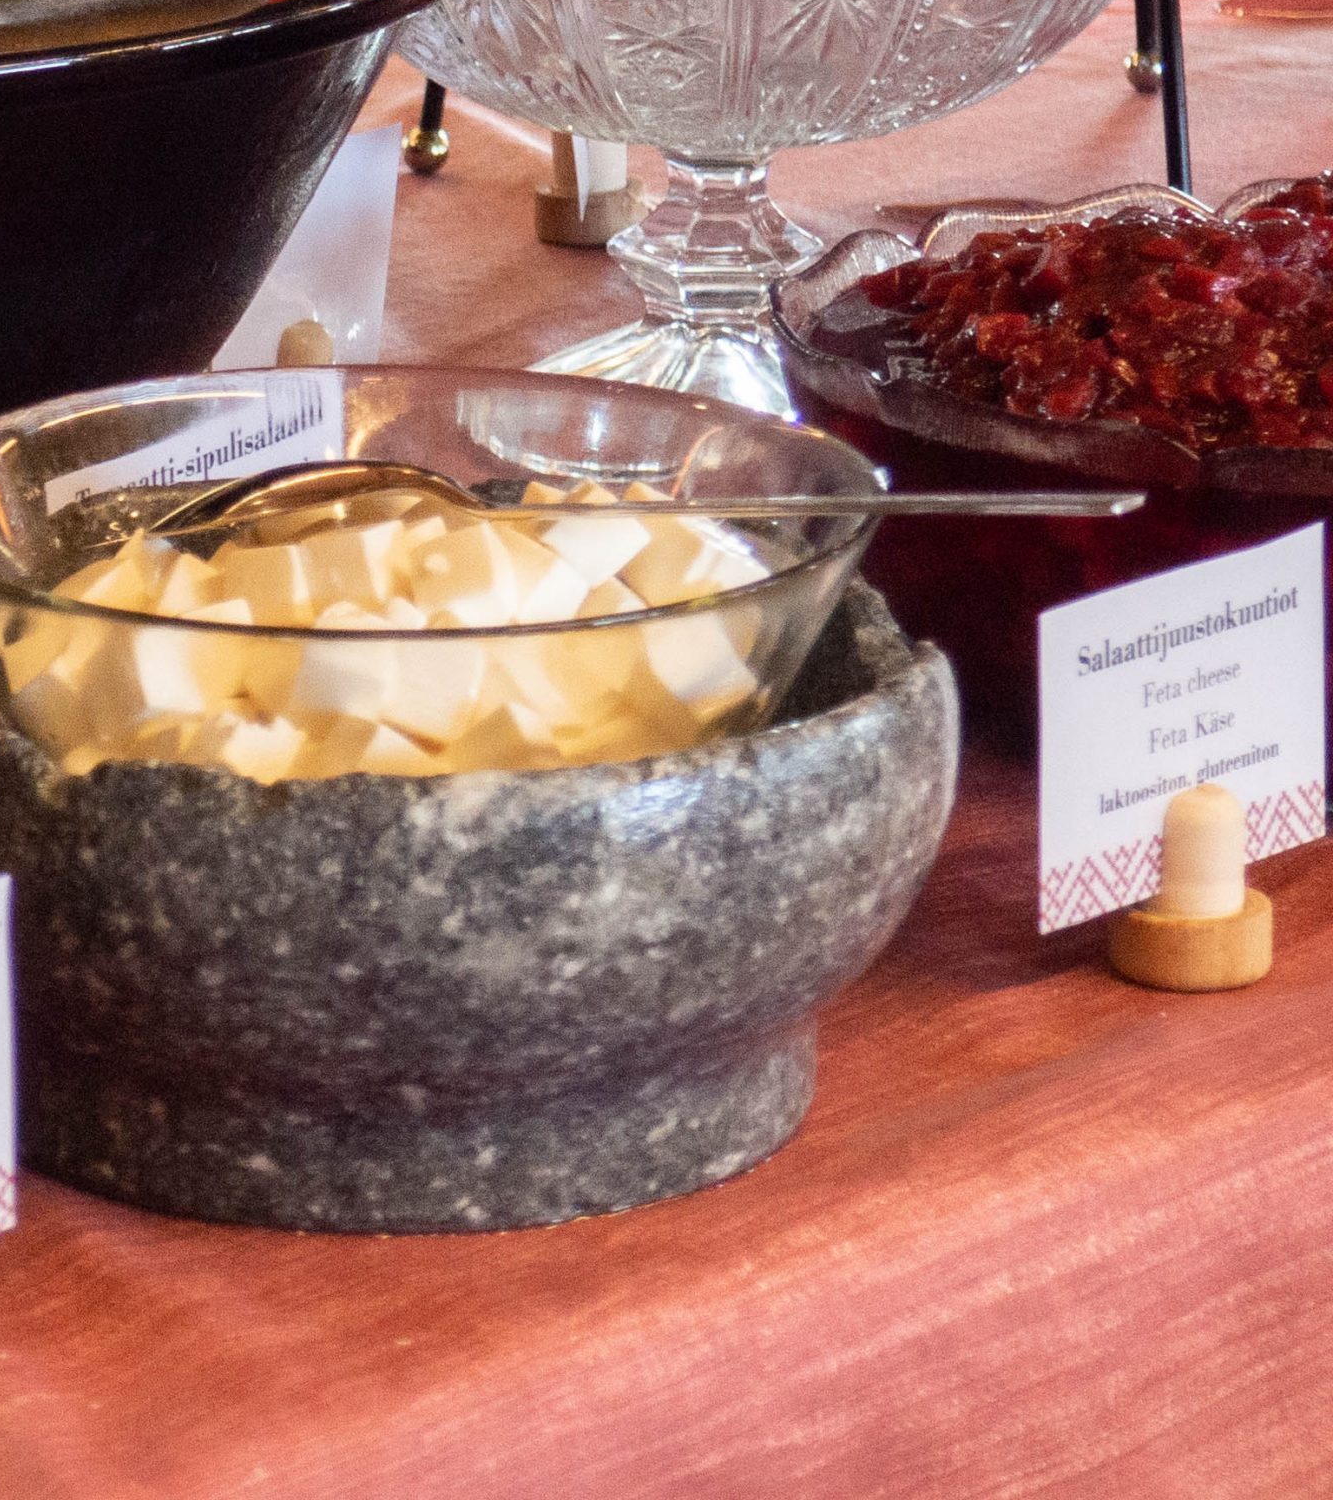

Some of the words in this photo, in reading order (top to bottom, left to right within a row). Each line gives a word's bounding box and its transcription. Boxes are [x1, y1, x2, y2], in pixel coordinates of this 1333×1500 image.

[1076, 586, 1299, 678] Salaattijuustokuutiot
[1142, 681, 1182, 708] Feta
[1186, 661, 1242, 695] cheese
[1148, 727, 1188, 755] Feta
[1194, 710, 1236, 739] Käse
